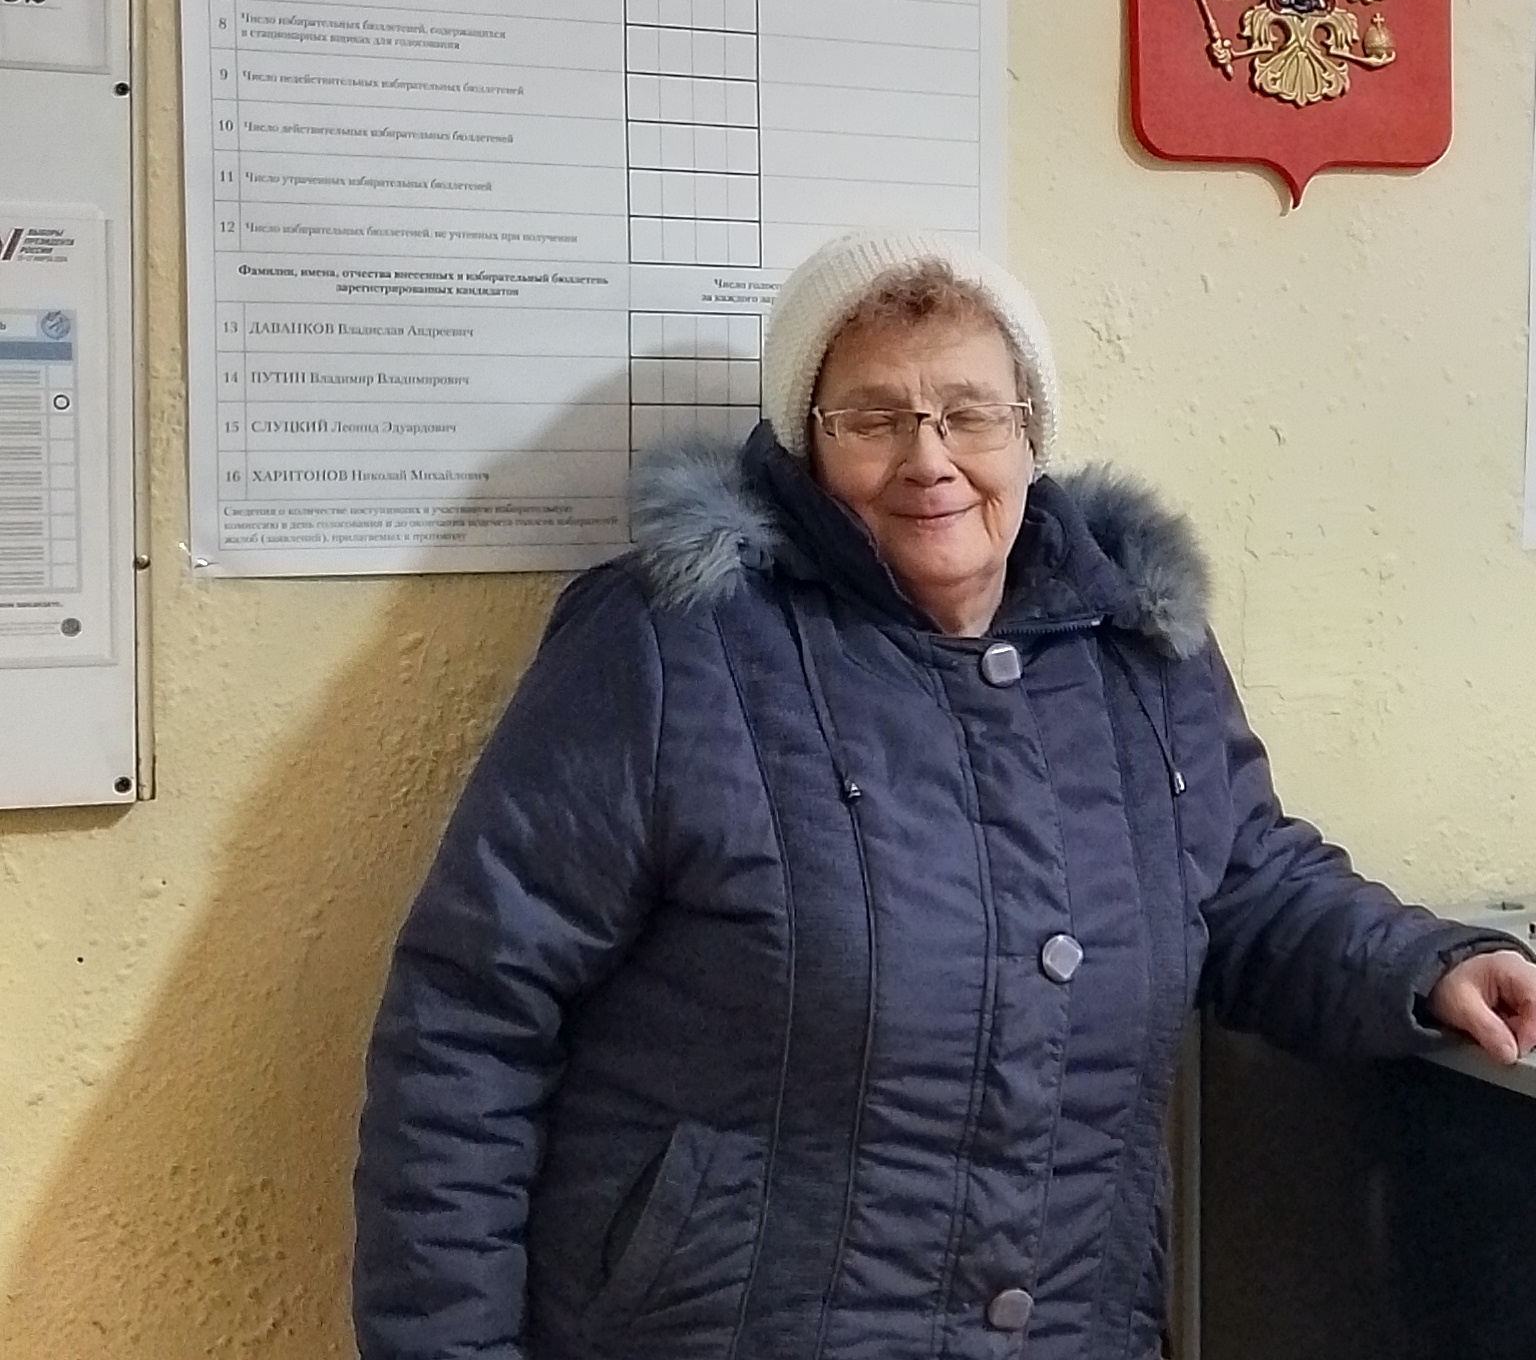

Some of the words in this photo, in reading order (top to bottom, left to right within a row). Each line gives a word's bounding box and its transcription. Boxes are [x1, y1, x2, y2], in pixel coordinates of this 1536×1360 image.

[218, 17, 228, 30] 8
[219, 67, 229, 83] 9
[218, 119, 235, 133] 10
[219, 170, 235, 184] 11
[220, 220, 236, 234] 12
[238, 263, 299, 280] Фамилии,
[342, 269, 392, 281] отчества
[335, 282, 455, 299] зарегистрированных
[222, 320, 239, 335] 13
[248, 320, 335, 338] ДАВАНКОВ
[338, 324, 404, 339] Владислав
[407, 324, 474, 340] Андреевич
[223, 370, 239, 385] 14
[250, 371, 307, 386] ПУТИН
[310, 372, 375, 388] Владимир
[377, 373, 470, 388] Владимирович
[224, 420, 240, 434] 15
[251, 418, 330, 436] СЛУЦКИЙ
[331, 421, 380, 436] Леонид
[382, 422, 457, 438] Эдуардович
[225, 469, 241, 483] 16
[252, 469, 349, 484] ХАРИТОНОВ
[351, 468, 408, 484] Николай
[411, 468, 490, 485] Михайлович
